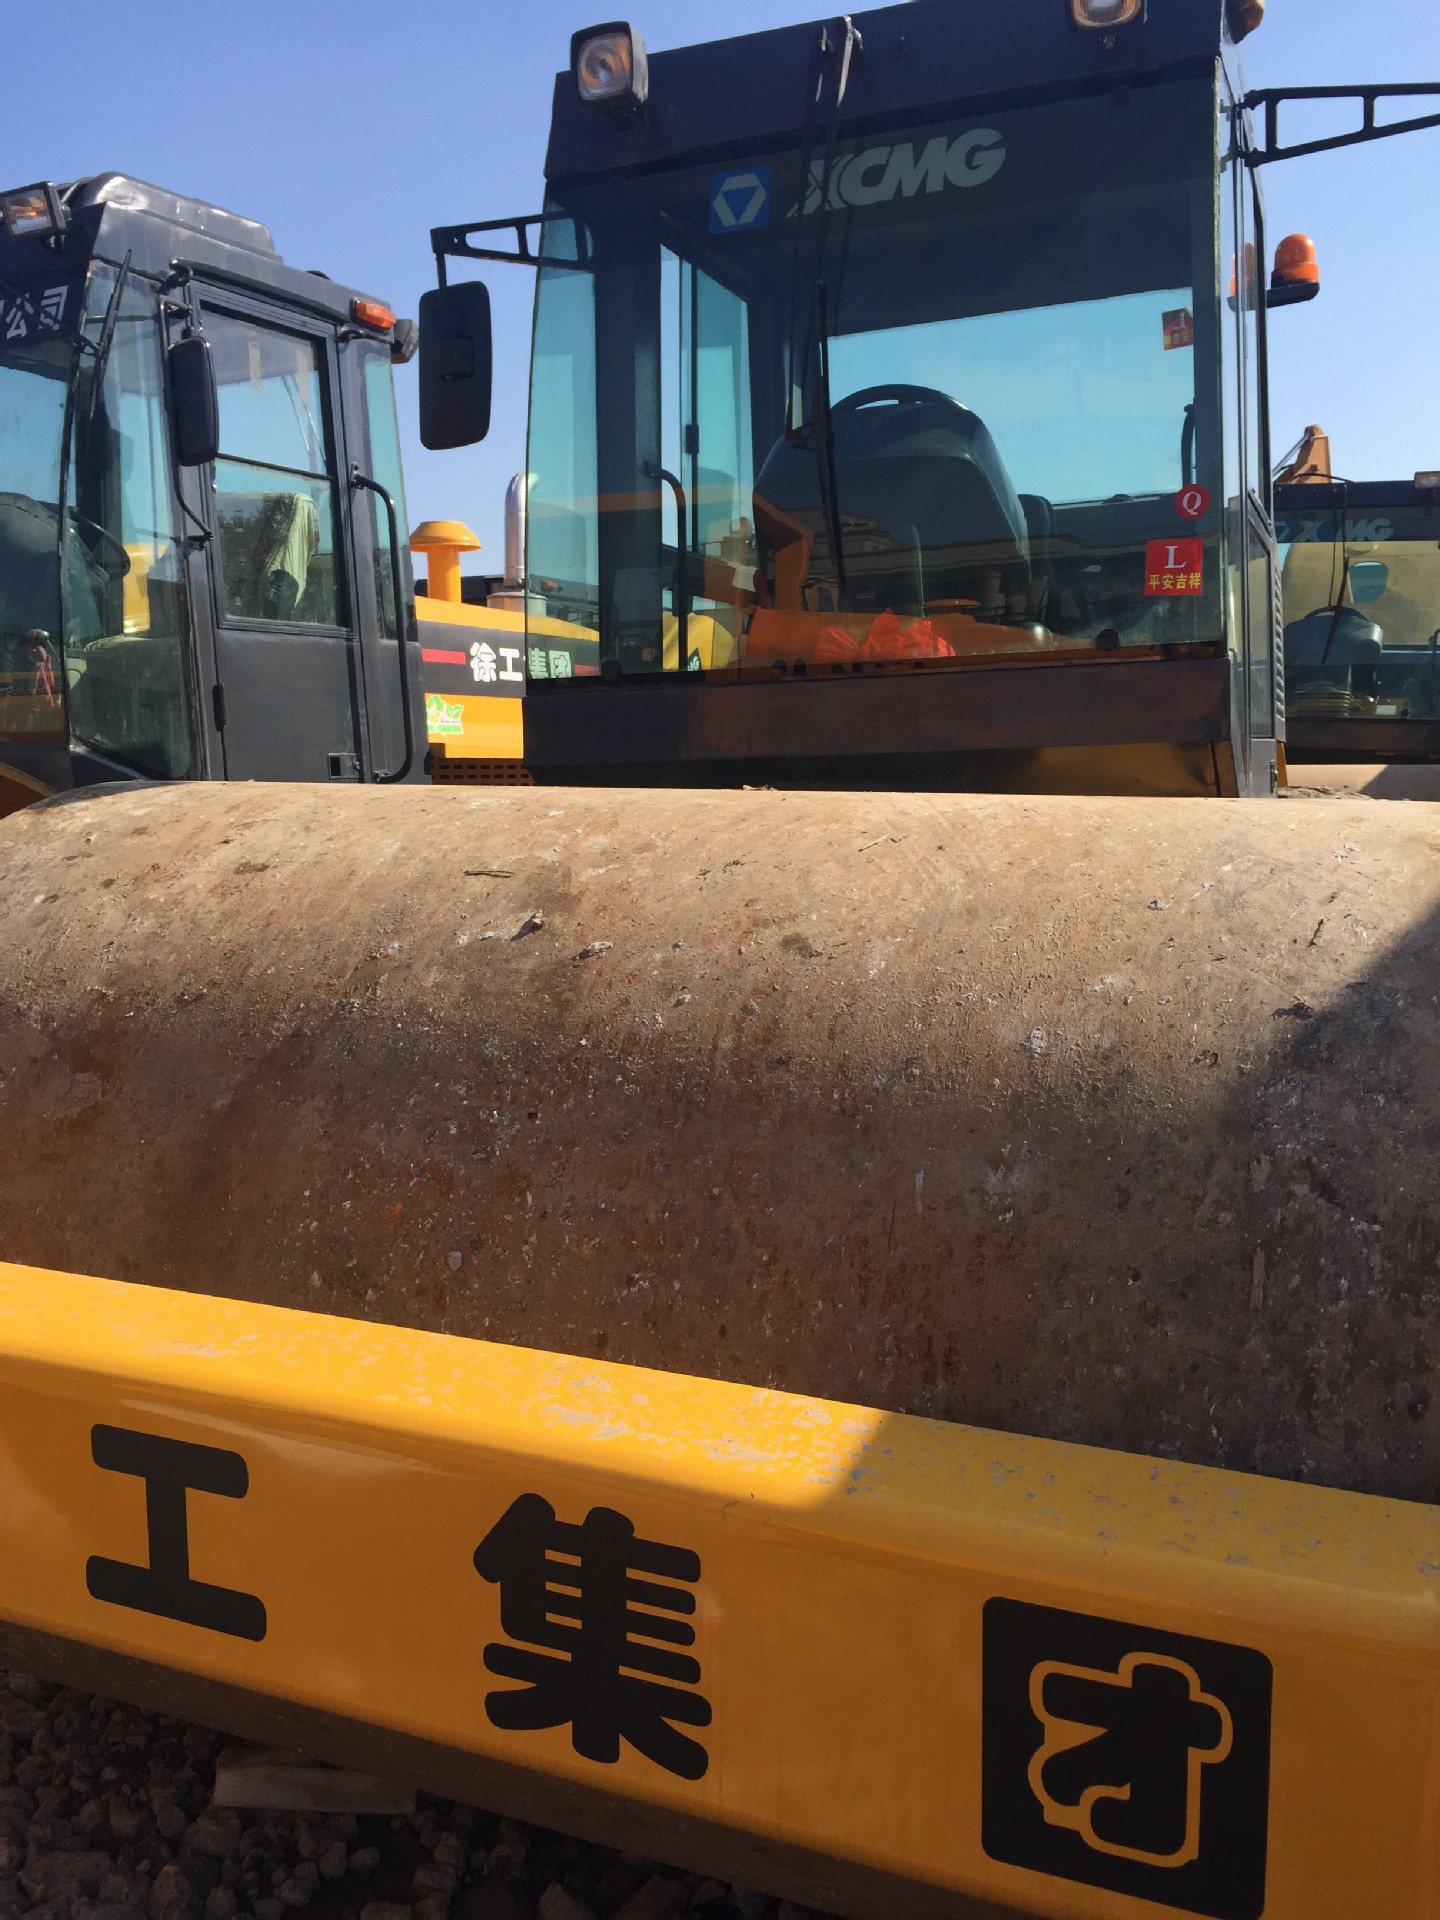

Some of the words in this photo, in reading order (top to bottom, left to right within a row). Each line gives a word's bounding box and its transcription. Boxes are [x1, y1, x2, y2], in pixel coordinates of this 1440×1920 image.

[785, 127, 1006, 218] XCMG
[0, 285, 69, 340] 公司
[1182, 491, 1202, 516] Q
[1293, 518, 1394, 542] XMG
[1164, 545, 1187, 569] L
[1148, 572, 1202, 591] 平安吉祥
[469, 642, 572, 682] 徐工集团
